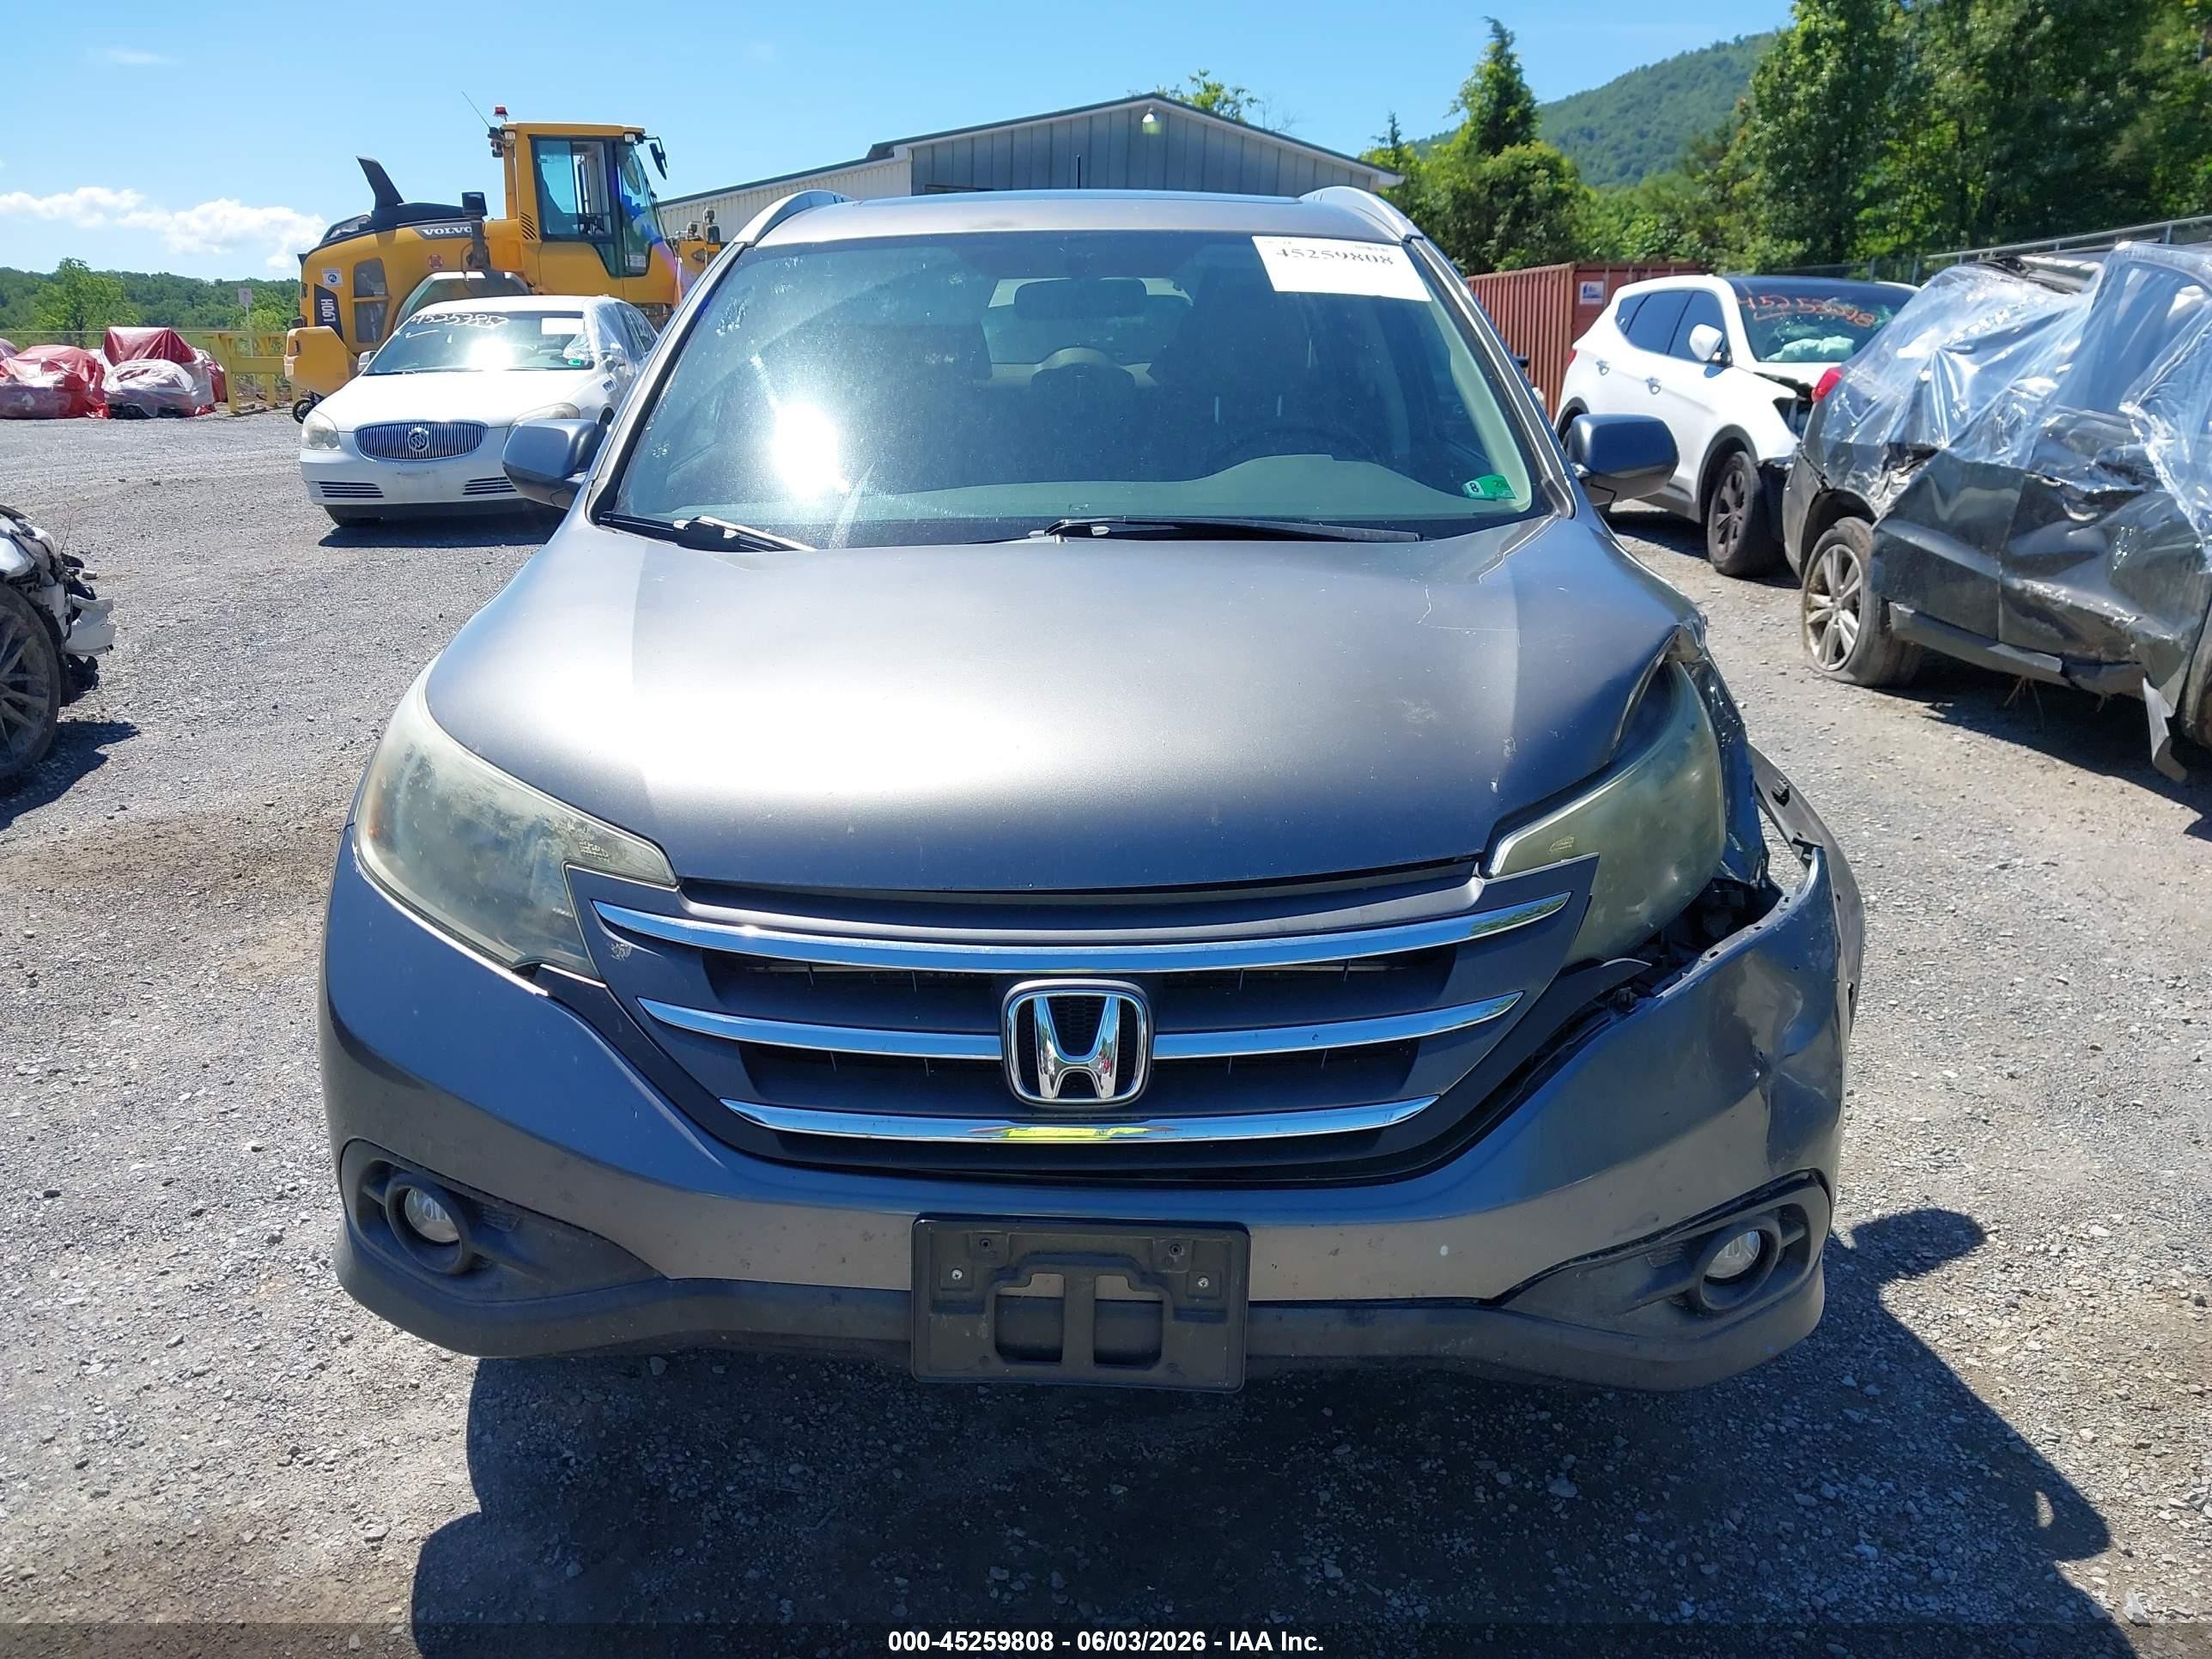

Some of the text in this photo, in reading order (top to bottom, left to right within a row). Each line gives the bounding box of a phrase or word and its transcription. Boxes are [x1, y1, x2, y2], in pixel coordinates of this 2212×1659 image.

[421, 226, 472, 235] VOLVO
[1275, 247, 1395, 265] 45259808
[320, 298, 337, 322] L90H
